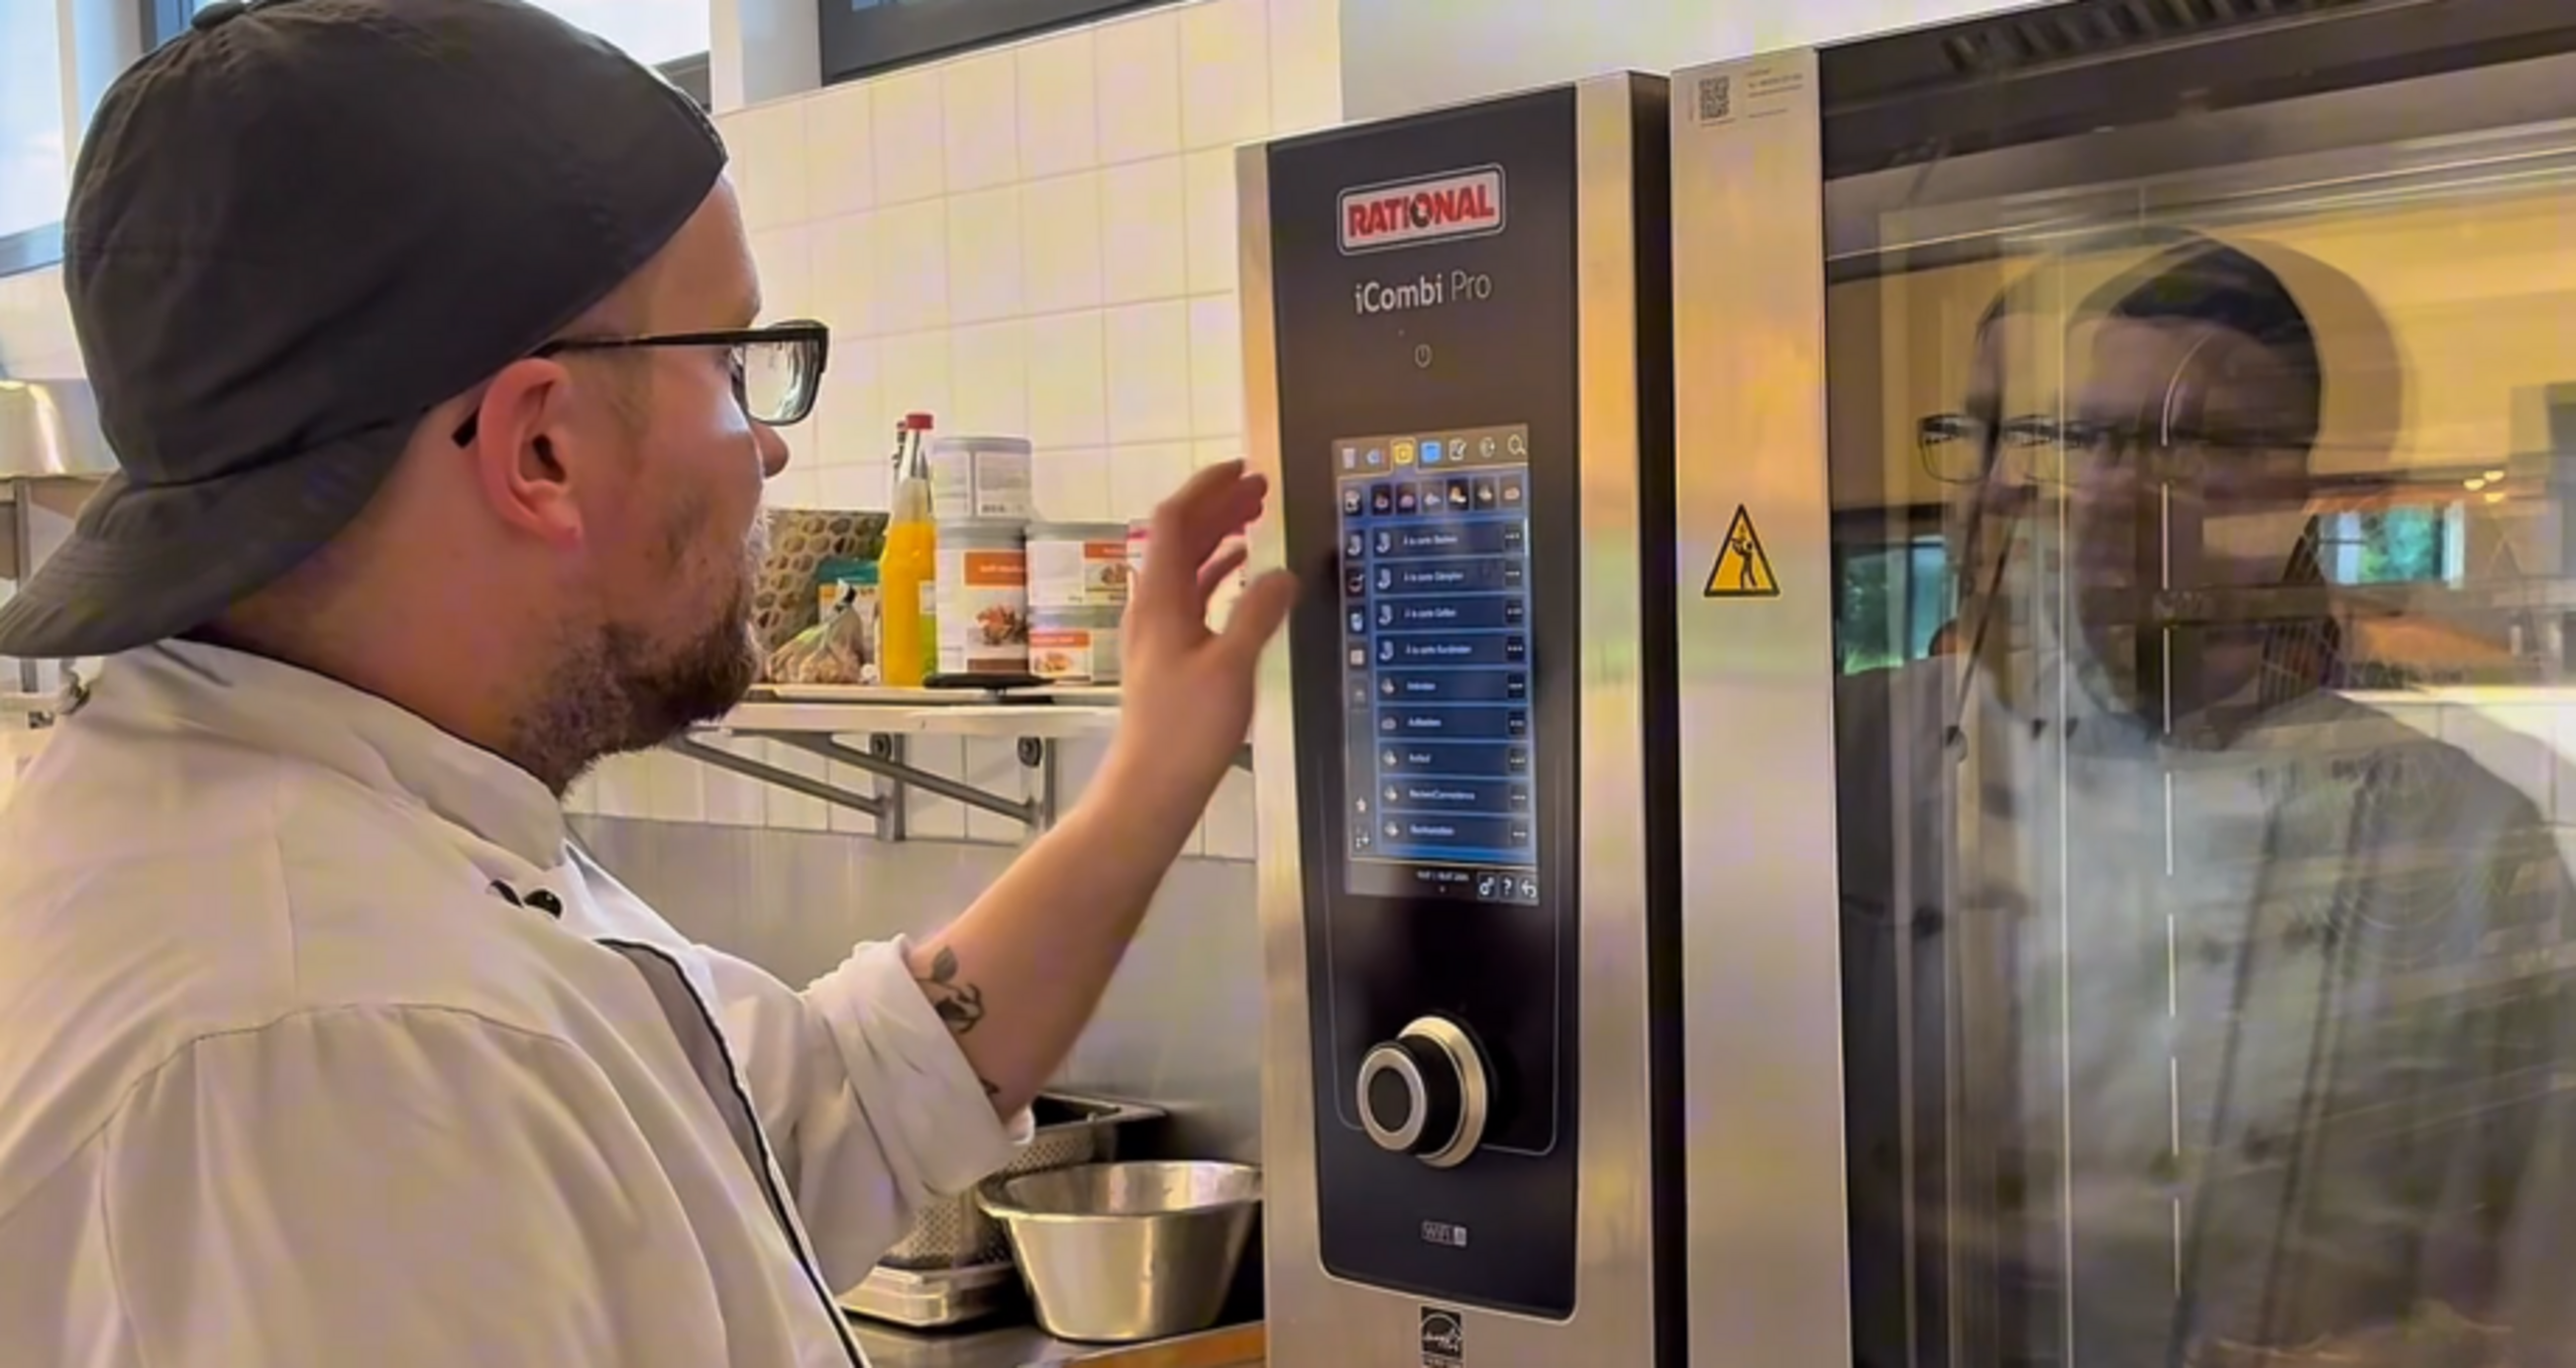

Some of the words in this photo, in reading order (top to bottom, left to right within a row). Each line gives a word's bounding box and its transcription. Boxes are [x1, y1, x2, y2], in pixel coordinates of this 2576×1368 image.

[1347, 184, 1495, 238] RATIONAL
[1354, 273, 1444, 314] iCombi
[1450, 269, 1492, 301] Pro
